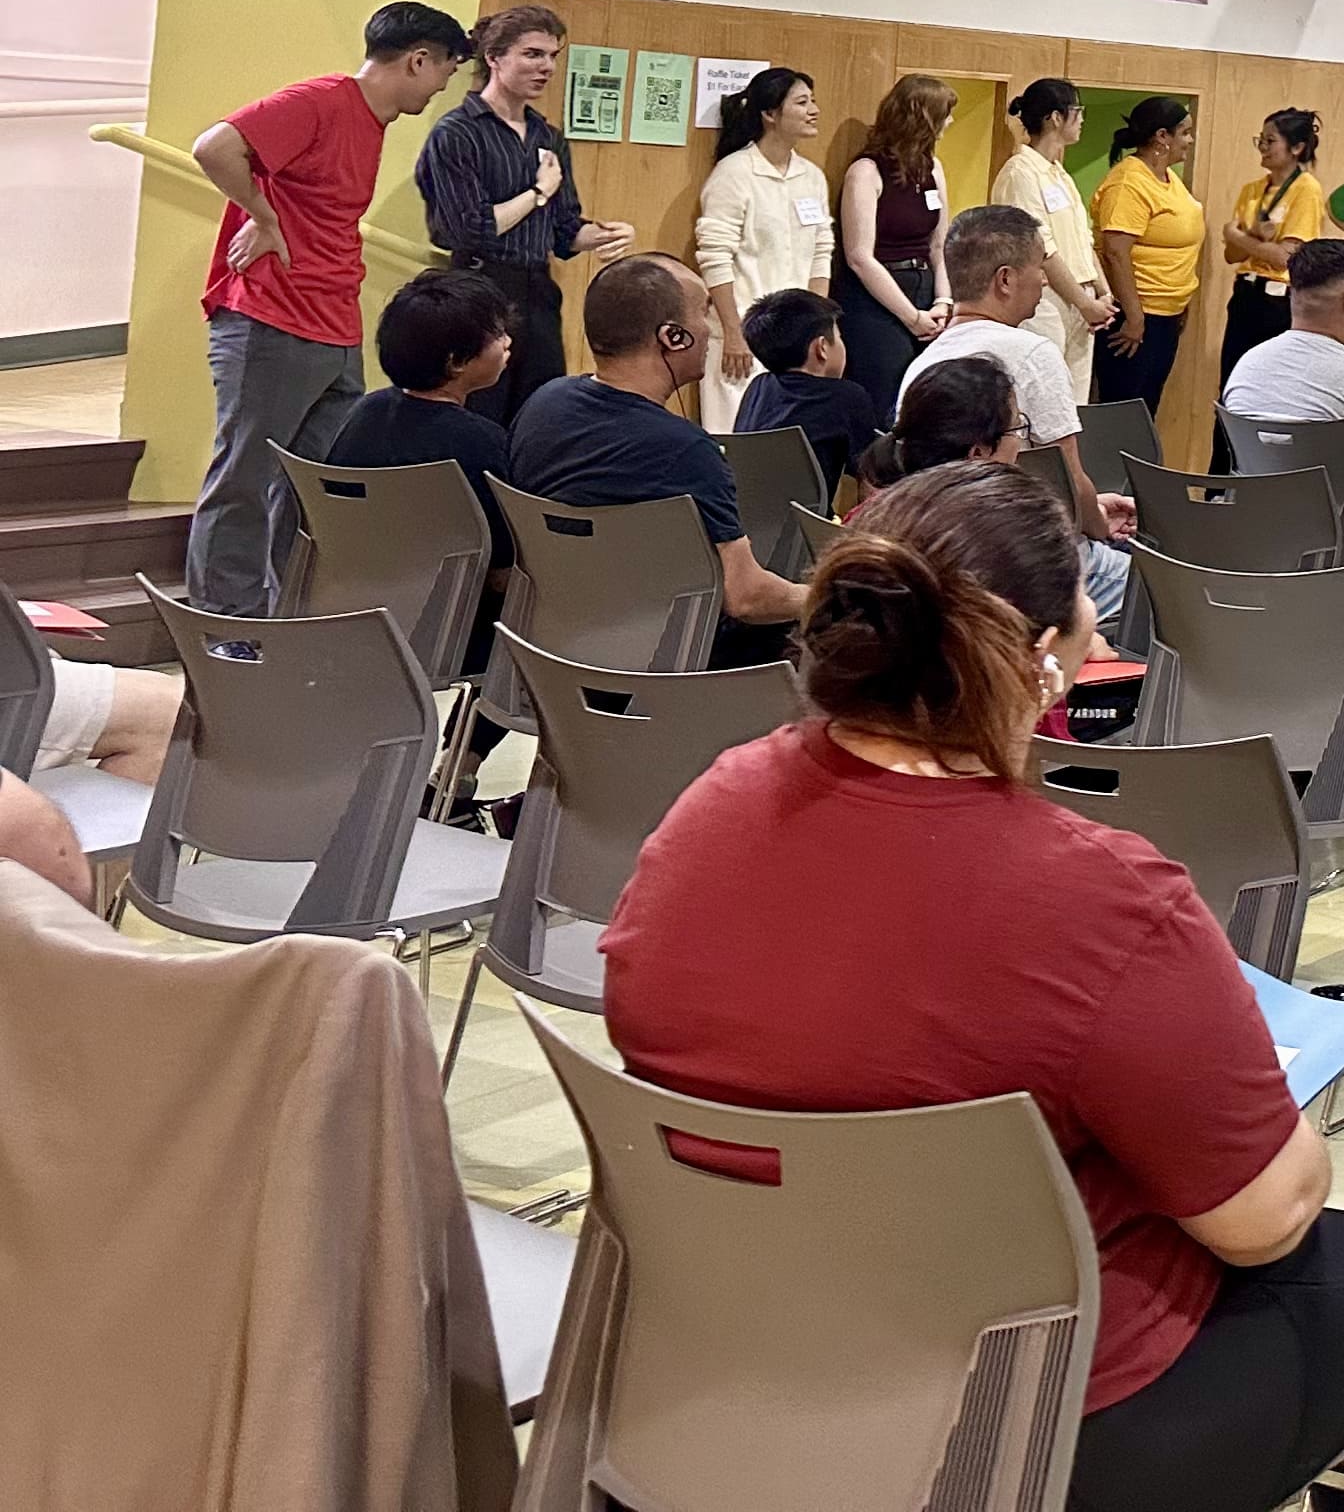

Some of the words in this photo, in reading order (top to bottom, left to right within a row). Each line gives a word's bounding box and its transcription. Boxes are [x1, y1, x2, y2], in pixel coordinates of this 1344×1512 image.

[707, 69, 728, 78] Raffle
[730, 71, 750, 79] Ticket
[718, 82, 729, 90] For
